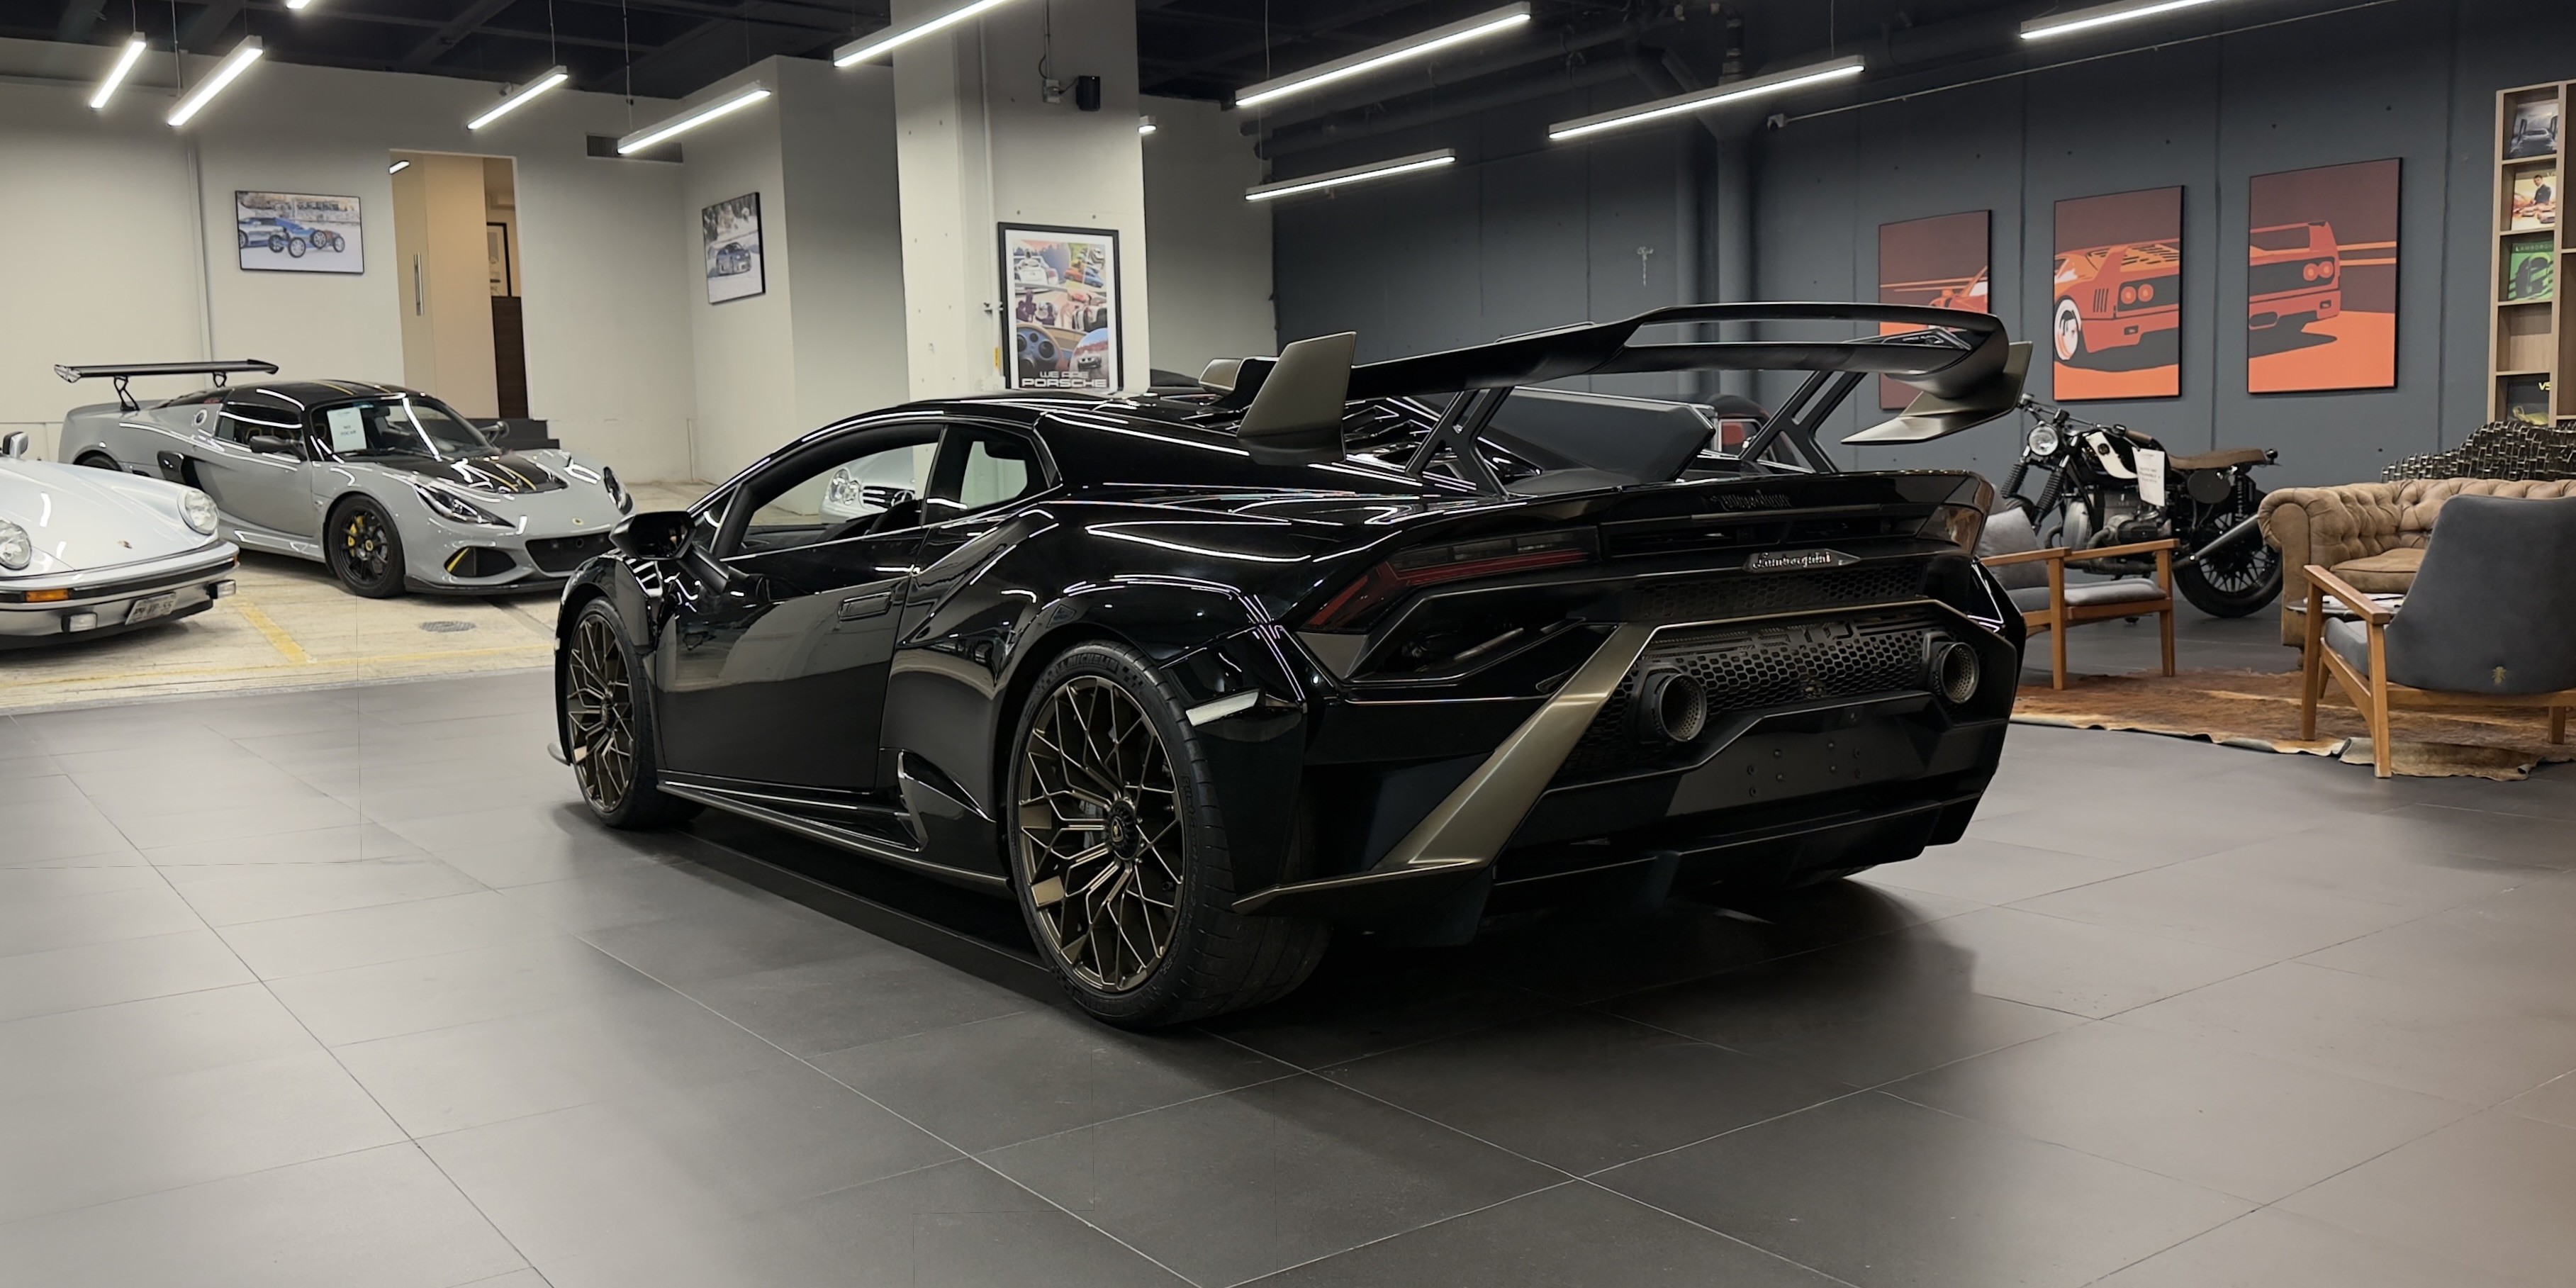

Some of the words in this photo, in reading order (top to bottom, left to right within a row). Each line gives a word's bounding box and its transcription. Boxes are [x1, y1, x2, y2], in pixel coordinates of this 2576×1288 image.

[1021, 378, 1107, 388] PORSCHE
[1752, 551, 1831, 569] Lamborghini
[1067, 652, 1119, 674] MICHELIN
